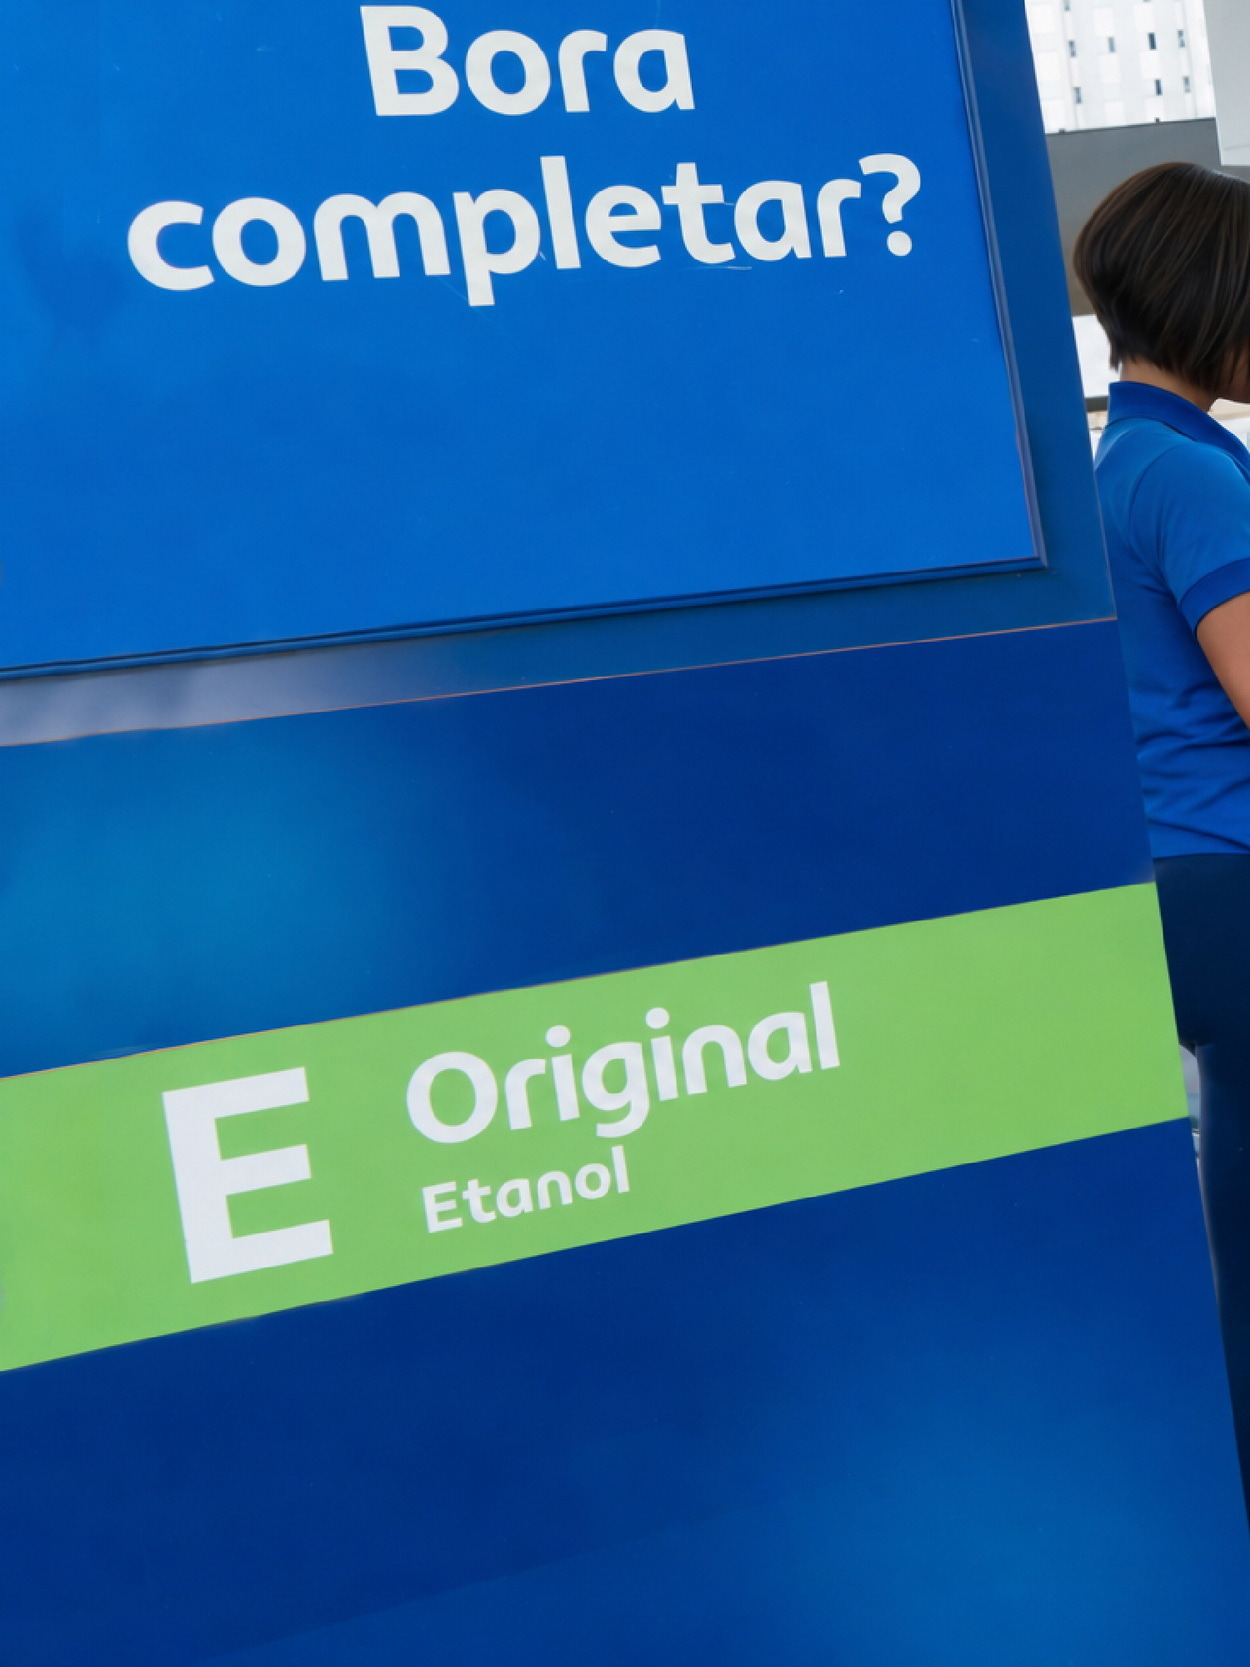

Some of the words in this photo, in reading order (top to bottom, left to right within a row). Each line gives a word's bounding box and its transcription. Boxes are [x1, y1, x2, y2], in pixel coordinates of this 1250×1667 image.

[360, 6, 694, 116] Bora
[128, 154, 920, 306] completar?
[406, 982, 840, 1143] Original
[162, 1067, 333, 1283] E
[422, 1146, 629, 1233] Etanol
